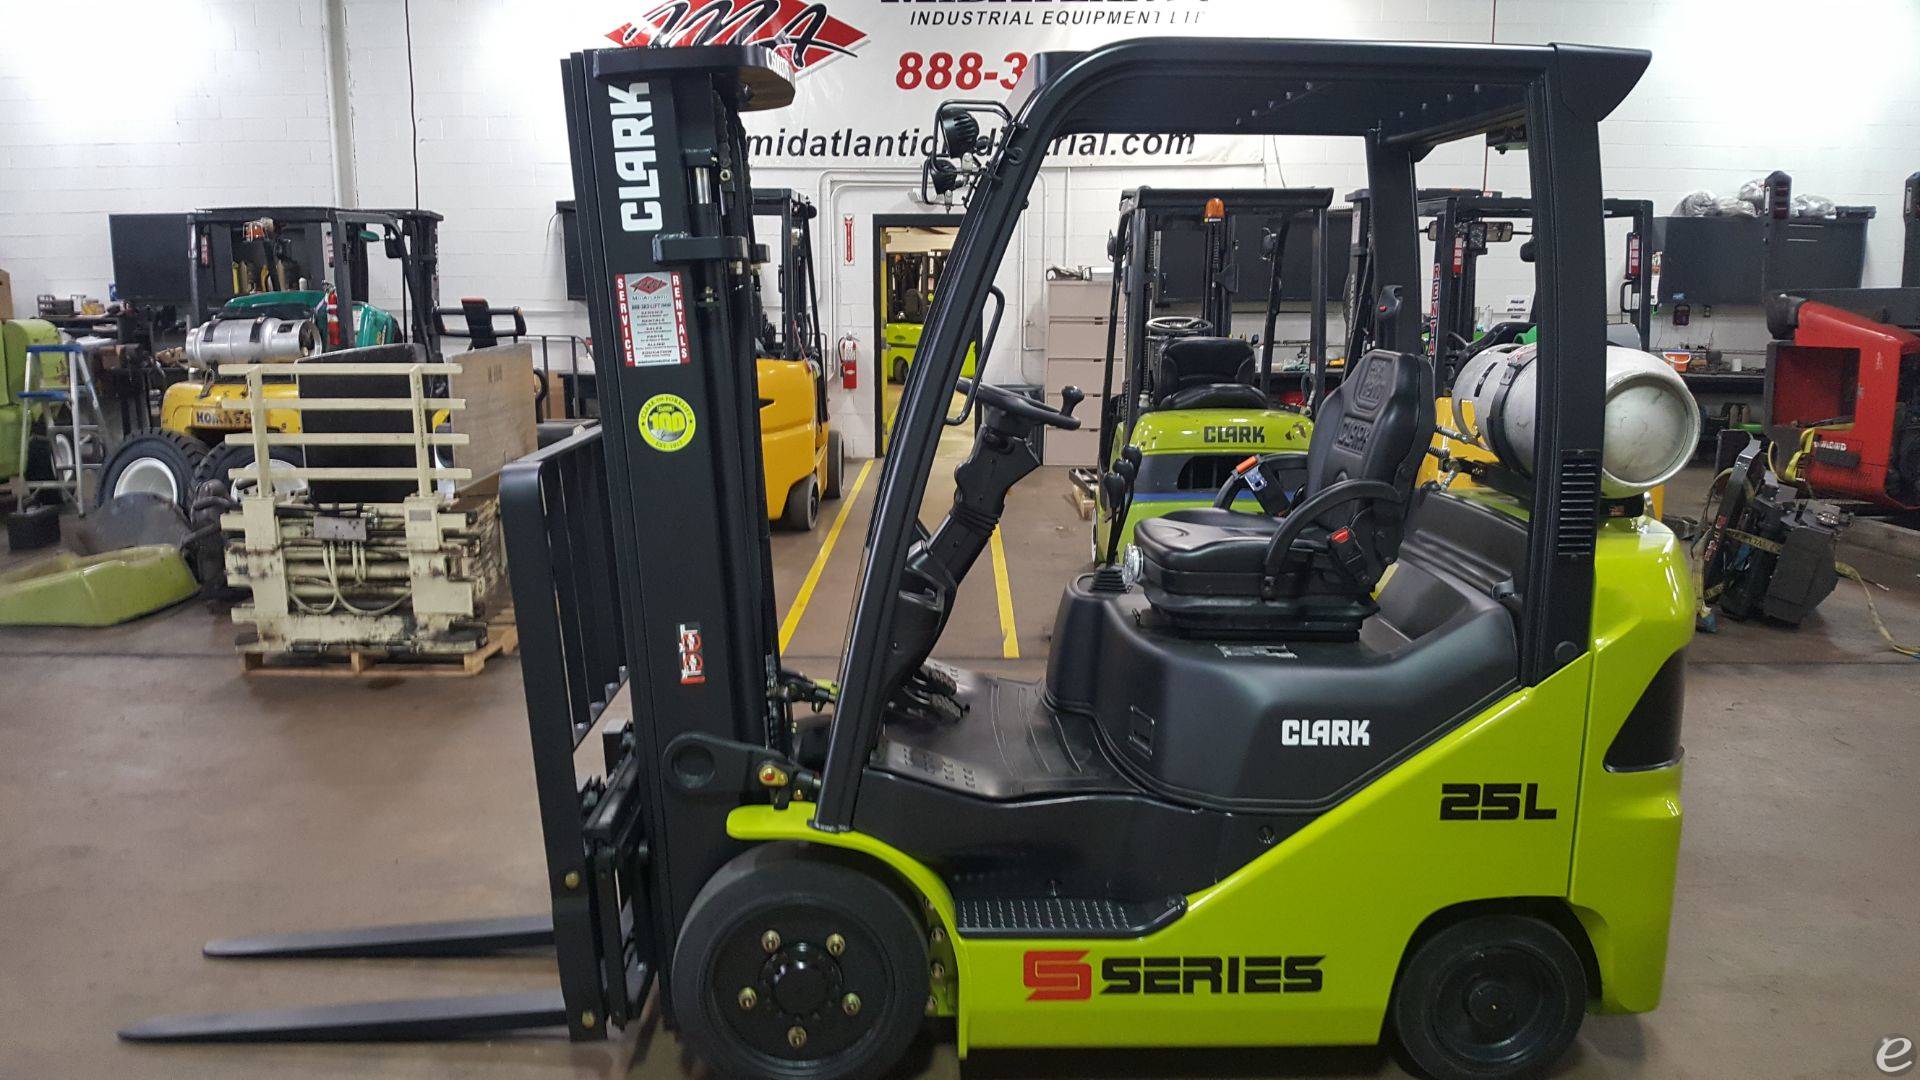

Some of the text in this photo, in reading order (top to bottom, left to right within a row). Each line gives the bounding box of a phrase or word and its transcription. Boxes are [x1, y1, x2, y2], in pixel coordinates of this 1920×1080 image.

[910, 10, 1034, 25] INDUSTRIAL
[1042, 10, 1161, 26] EQUIPMENT
[896, 51, 1028, 90] 888-3
[608, 82, 663, 232] CLARK
[617, 278, 633, 362] SERVICE
[672, 275, 688, 358] RENTALS
[648, 411, 686, 434] 100
[1203, 425, 1265, 443] CLARK
[1281, 719, 1370, 747] CLARK
[1440, 783, 1557, 820] 25L
[1023, 950, 1326, 1001] S SERIES
